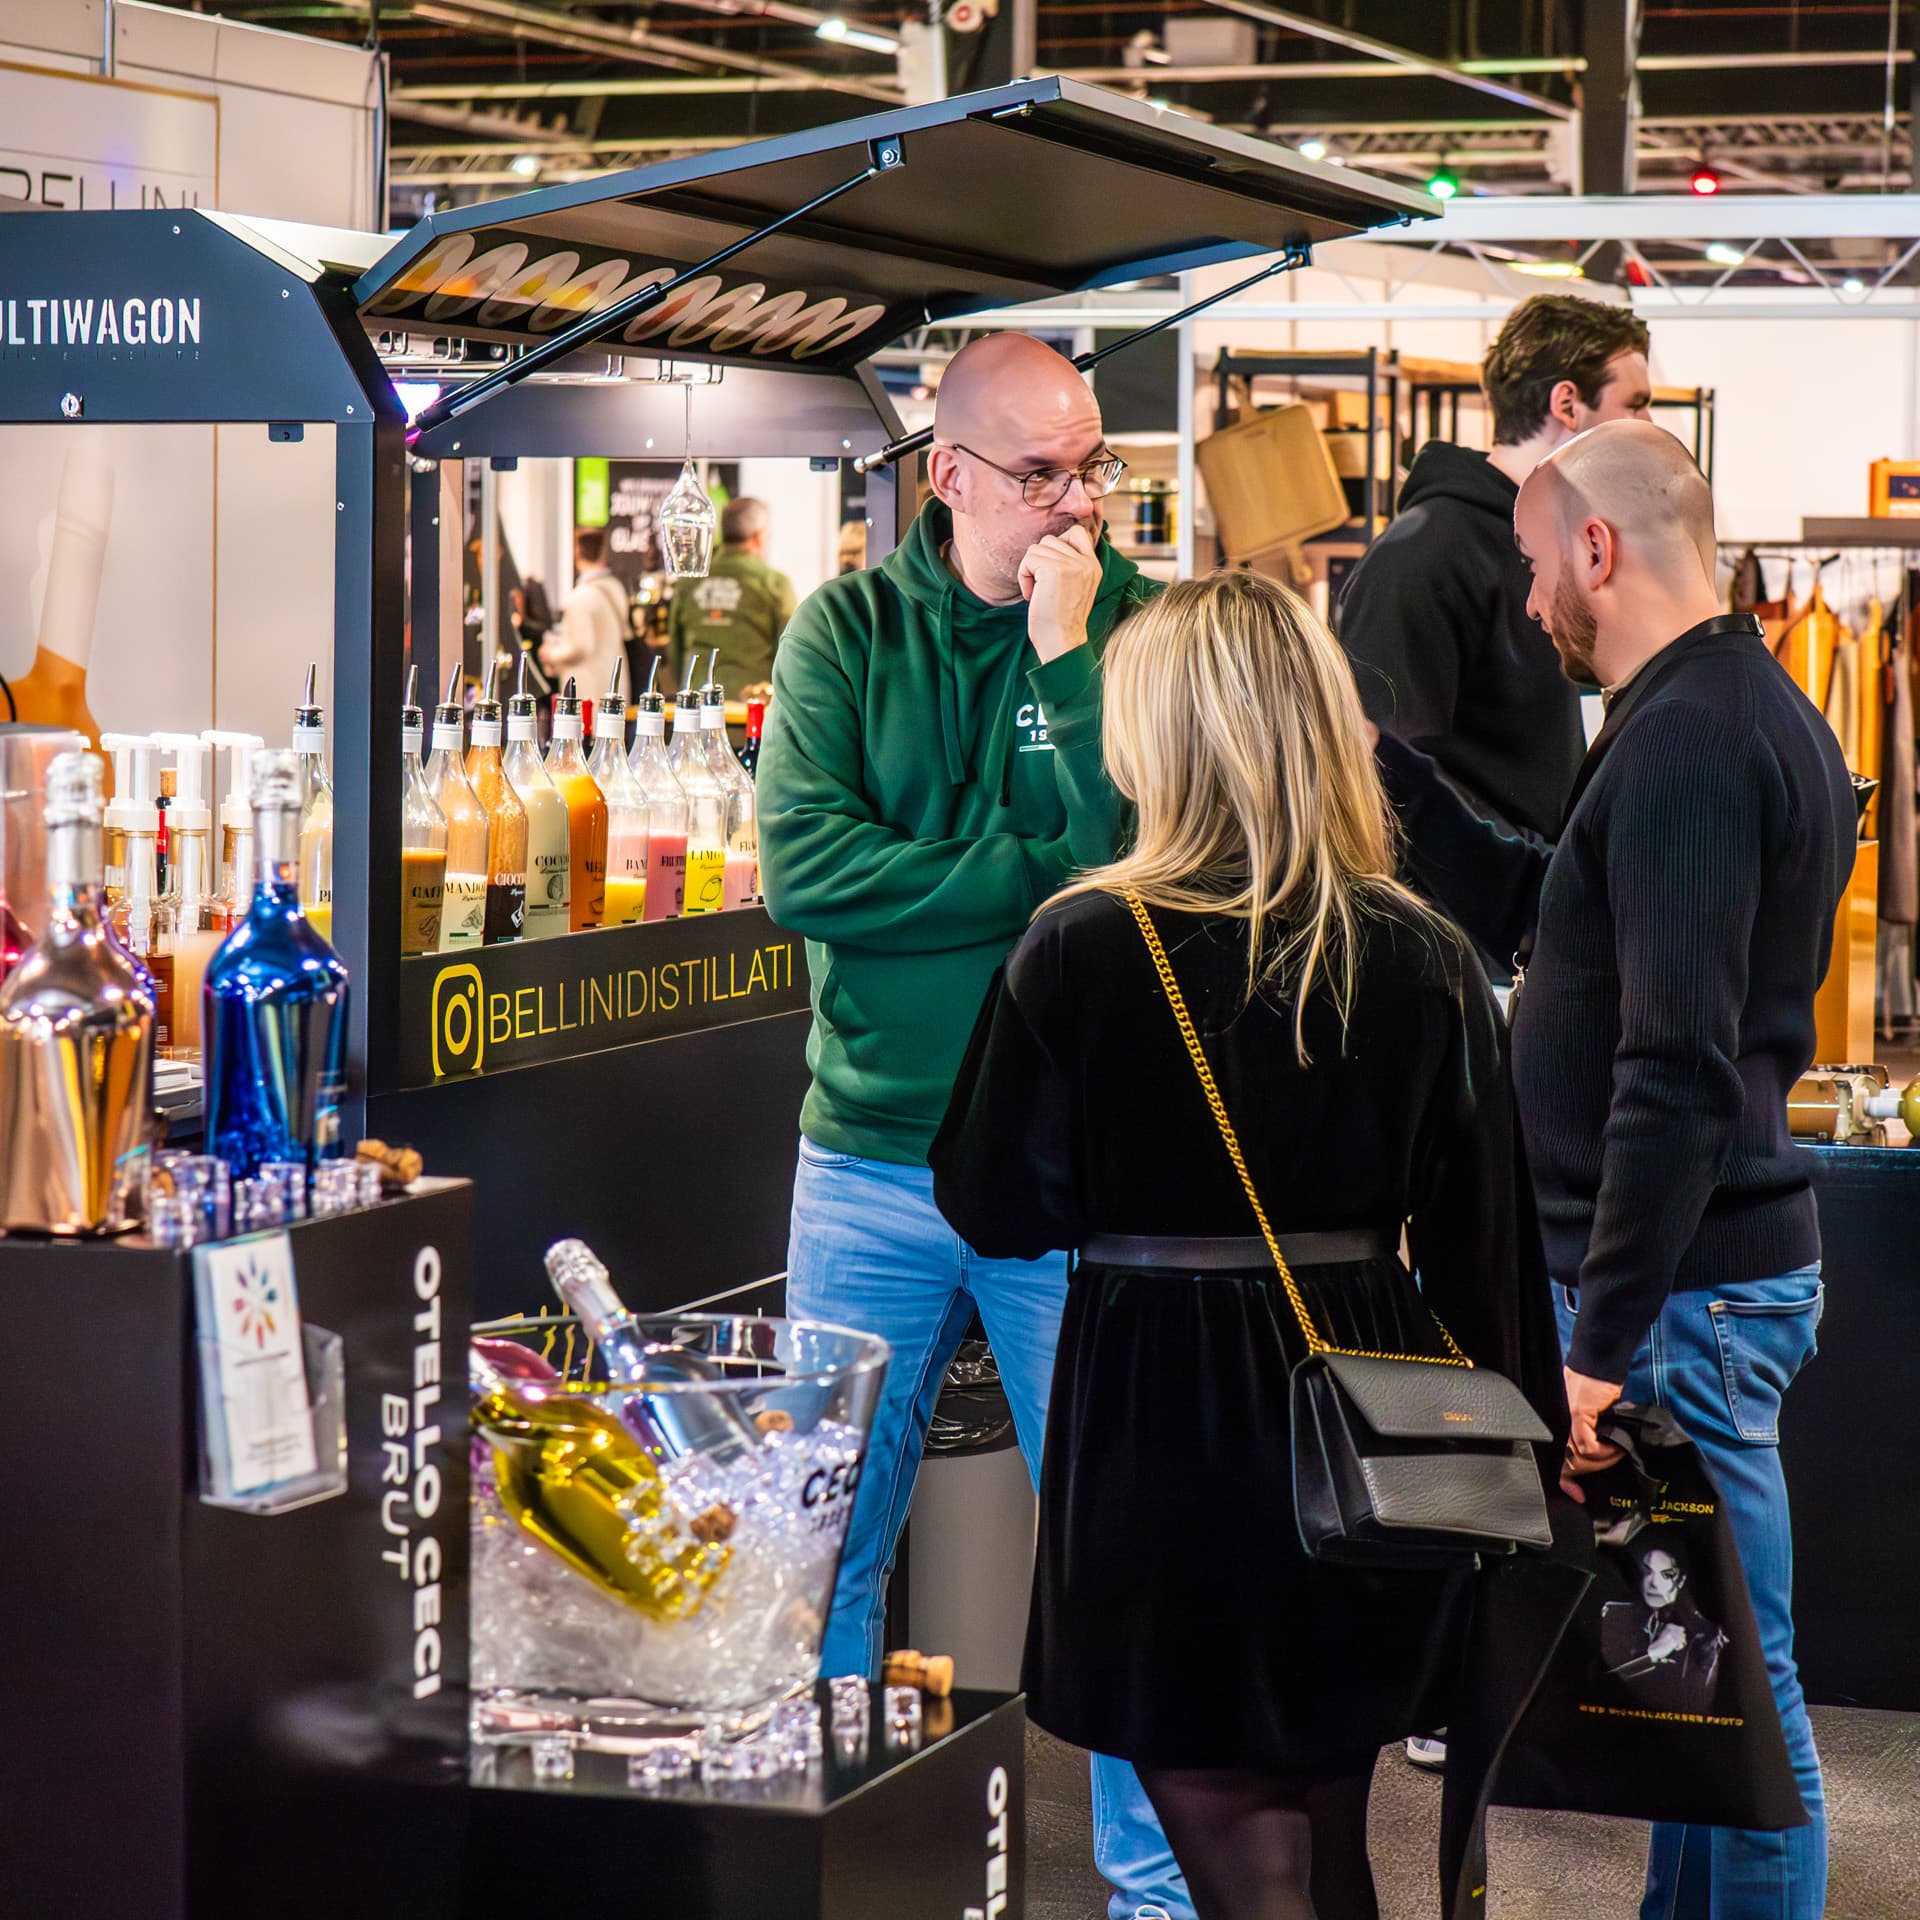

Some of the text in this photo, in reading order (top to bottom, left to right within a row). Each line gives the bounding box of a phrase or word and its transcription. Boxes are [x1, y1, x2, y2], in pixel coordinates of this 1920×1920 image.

[489, 943, 793, 1044] BELLINIDISTILLATI
[381, 1392, 410, 1580] BRUT
[413, 1245, 442, 1700] OTELLO CECI
